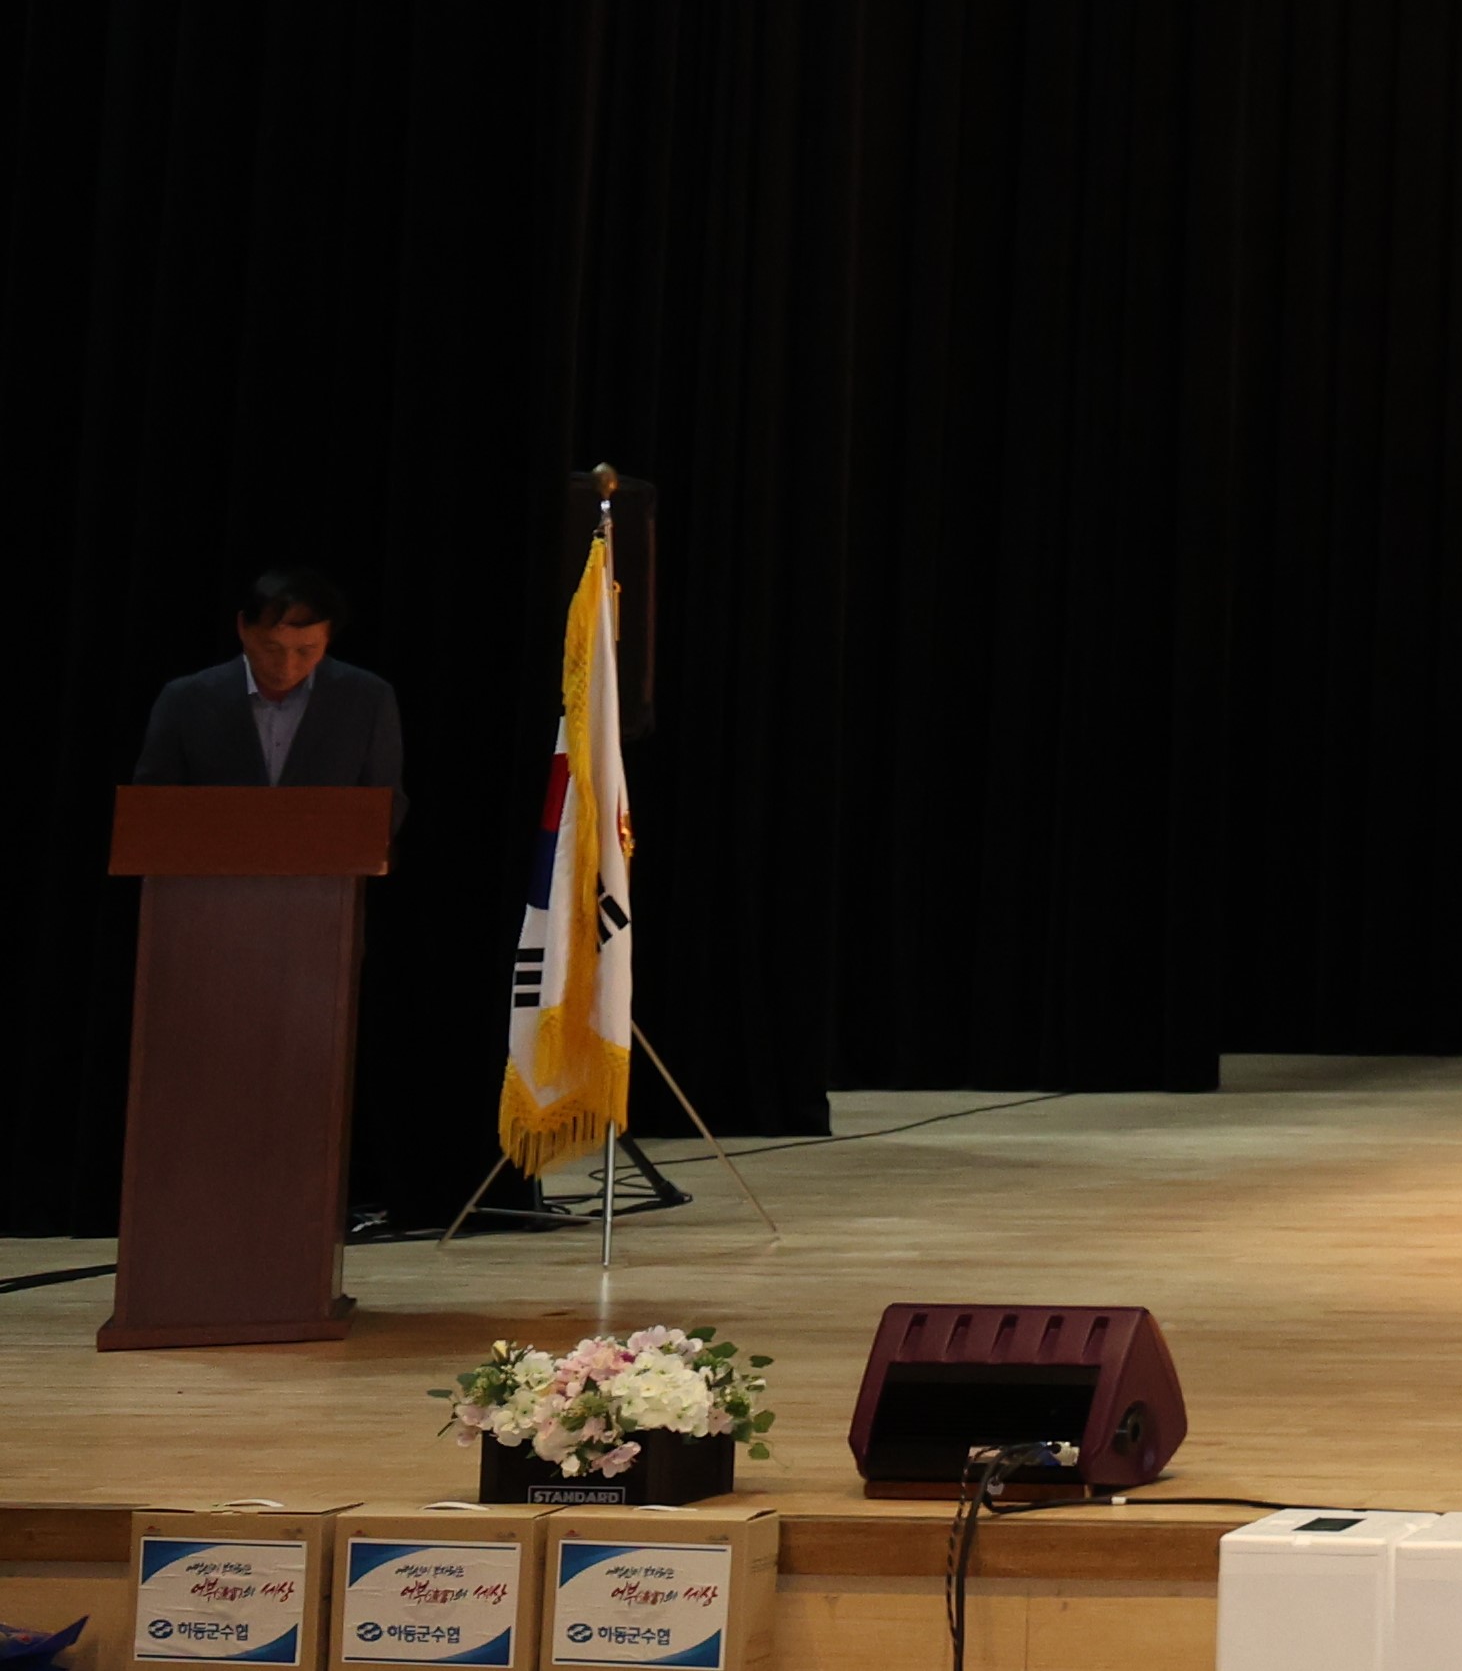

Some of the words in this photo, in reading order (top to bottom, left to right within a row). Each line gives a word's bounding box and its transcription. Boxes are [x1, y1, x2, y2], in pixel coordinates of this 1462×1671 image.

[533, 1491, 619, 1503] STANDARD
[178, 1623, 248, 1641] 하동군수협
[387, 1625, 460, 1643] 하동군수협
[598, 1627, 670, 1645] 하동군수협
